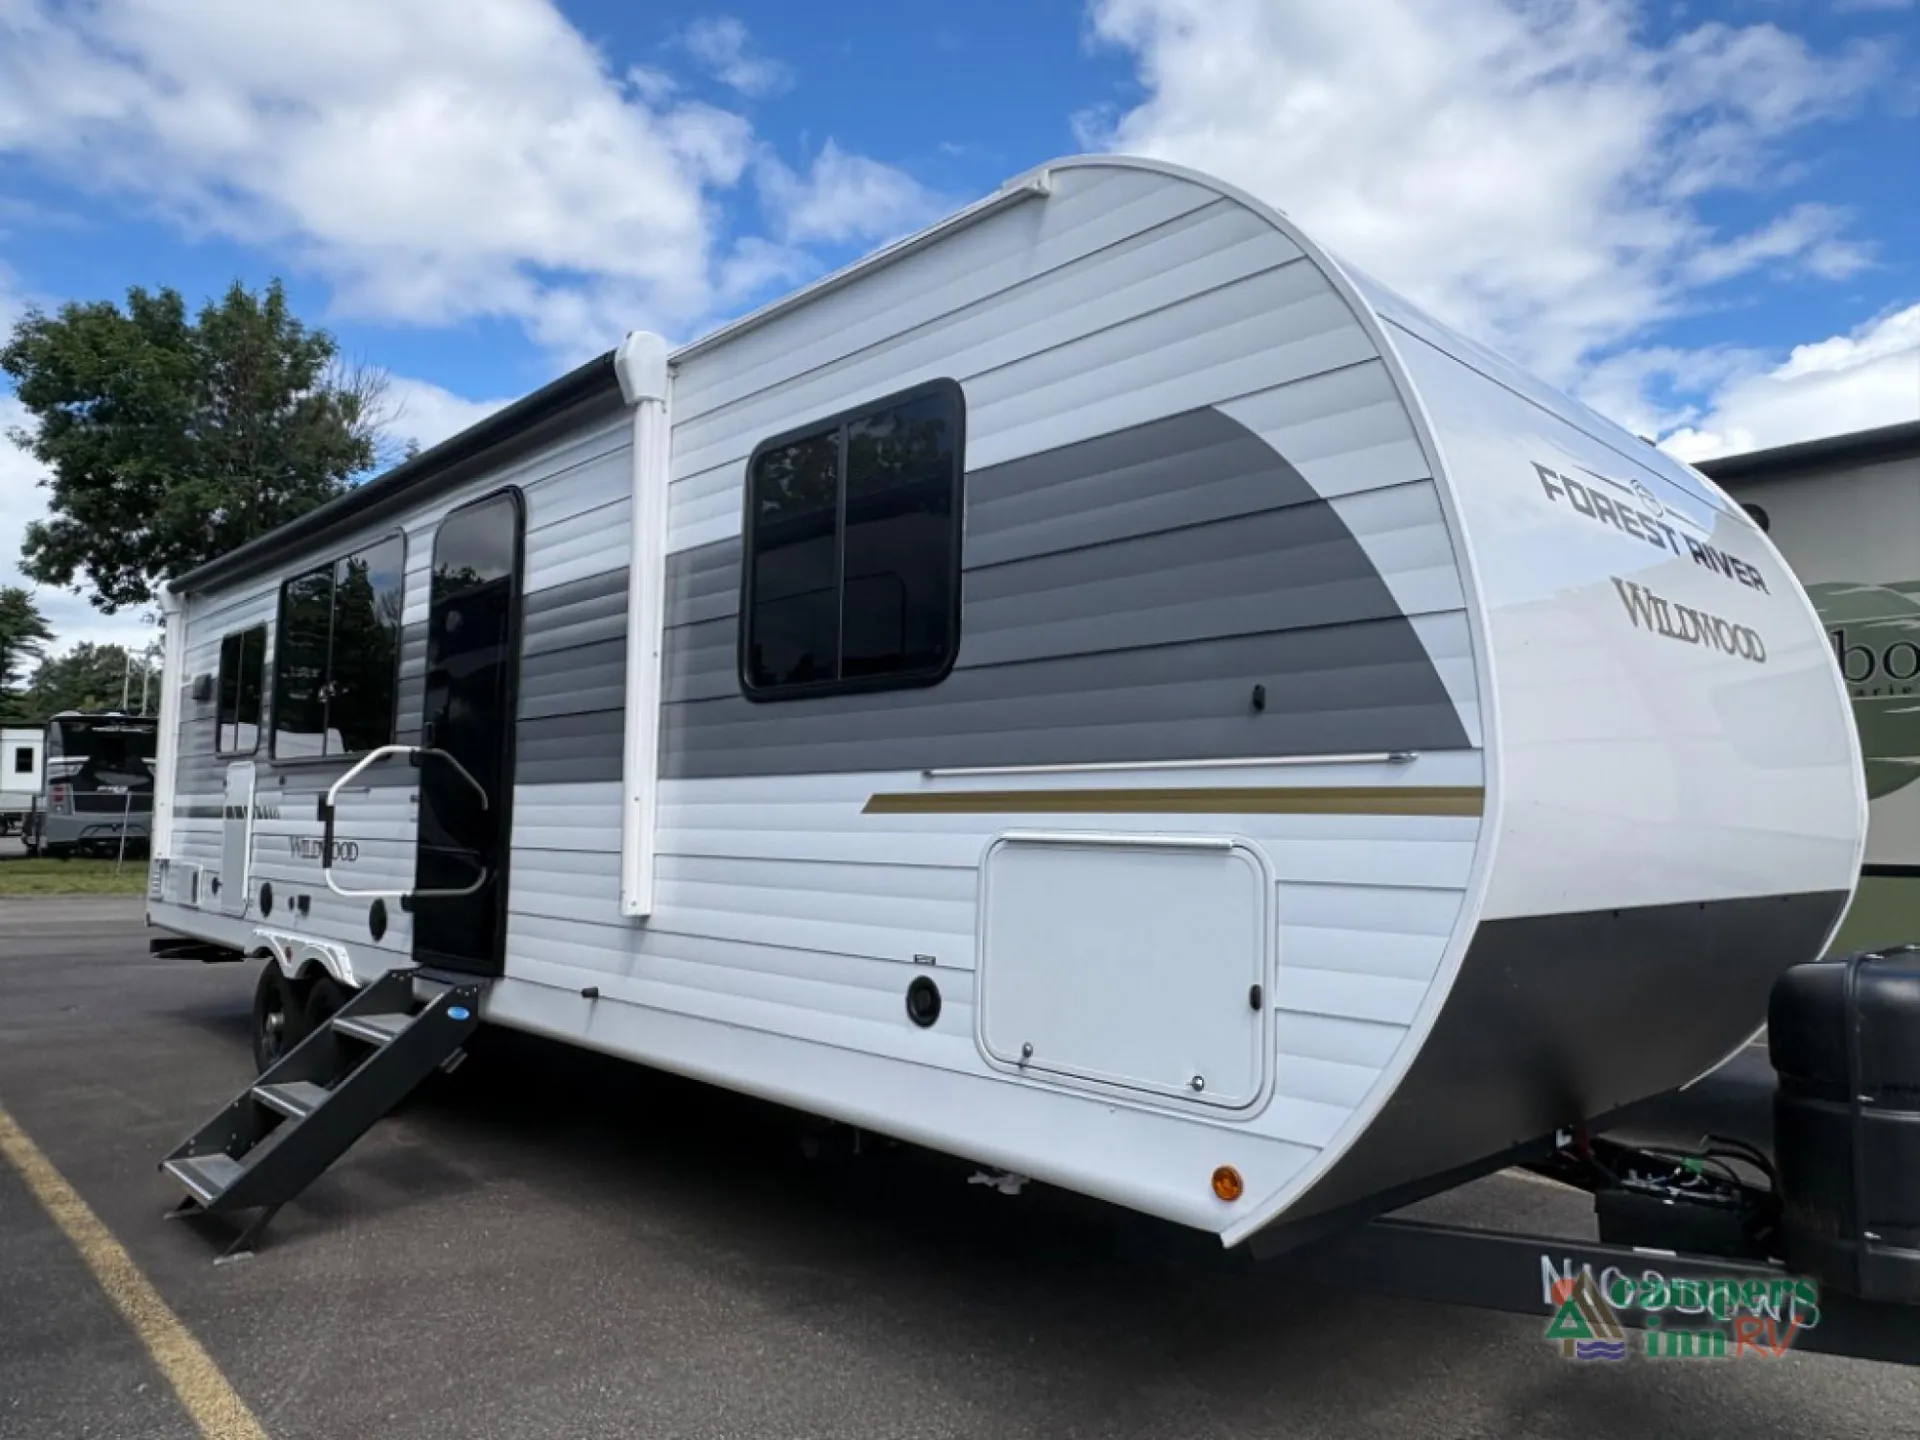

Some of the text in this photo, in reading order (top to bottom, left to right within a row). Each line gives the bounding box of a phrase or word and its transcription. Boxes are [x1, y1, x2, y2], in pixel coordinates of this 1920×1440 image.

[1531, 461, 1771, 596] FOREST RIVER
[1610, 576, 1767, 664] WILDWOOD
[288, 836, 359, 862] WILDOOD
